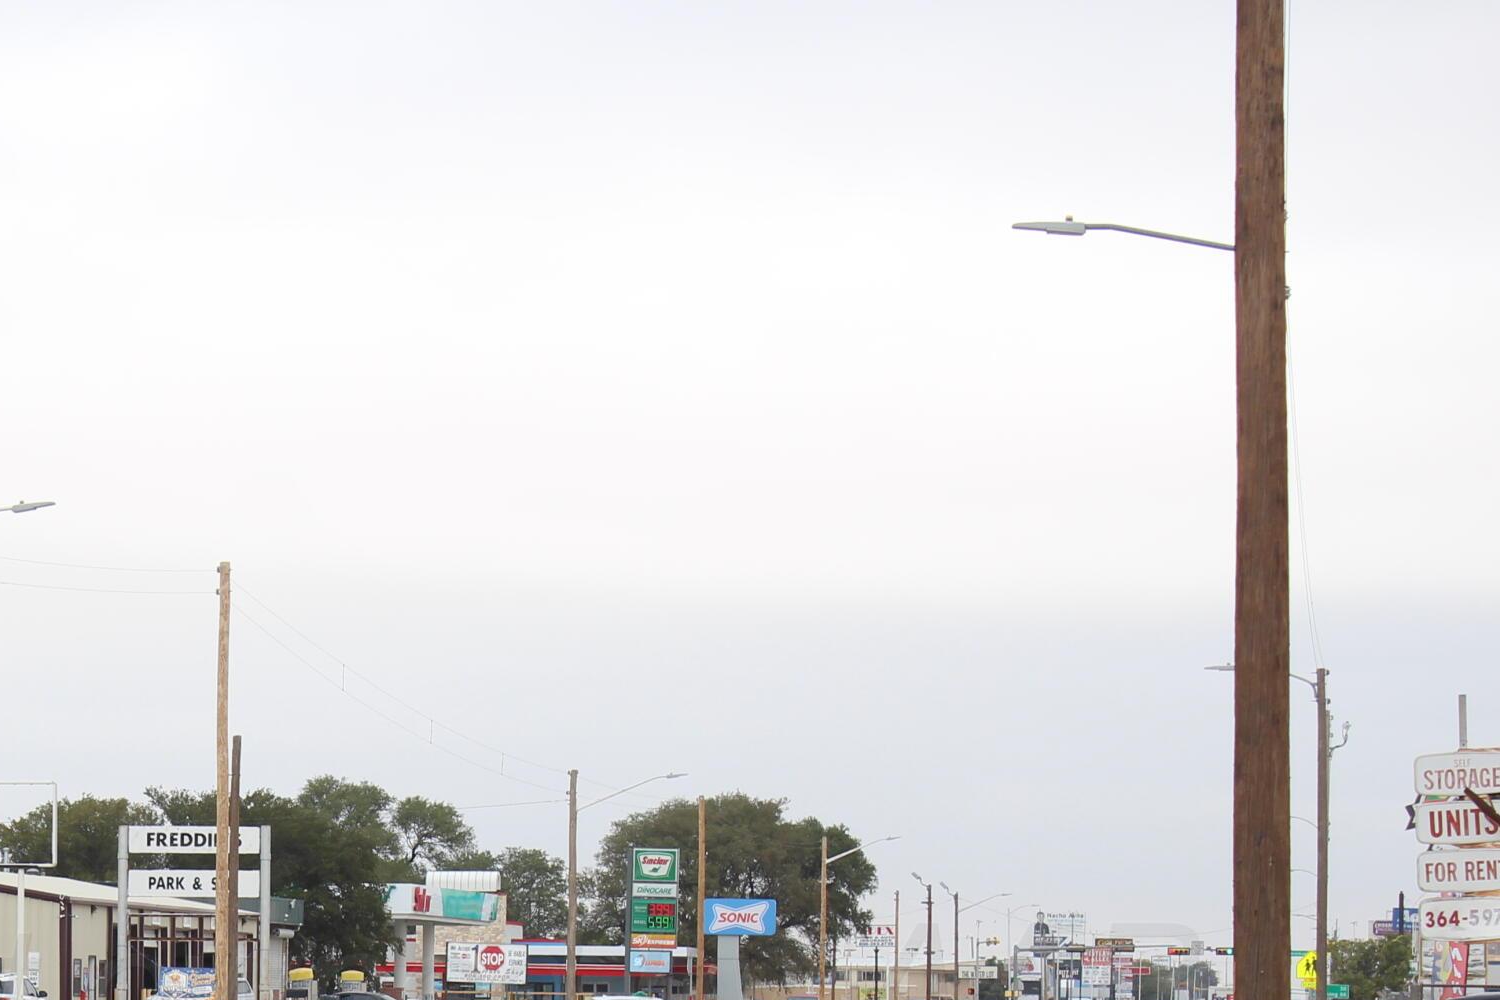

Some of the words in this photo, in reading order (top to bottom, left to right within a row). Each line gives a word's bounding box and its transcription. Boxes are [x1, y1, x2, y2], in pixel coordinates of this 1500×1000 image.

[1423, 767, 1500, 791] STORAGE
[146, 832, 242, 847] FREDDI
[642, 856, 669, 866] Sinclair
[1425, 861, 1458, 883] FOR
[148, 876, 185, 891] PARK
[192, 877, 203, 891] &
[718, 912, 760, 924] SONIC
[481, 952, 505, 966] STOP
